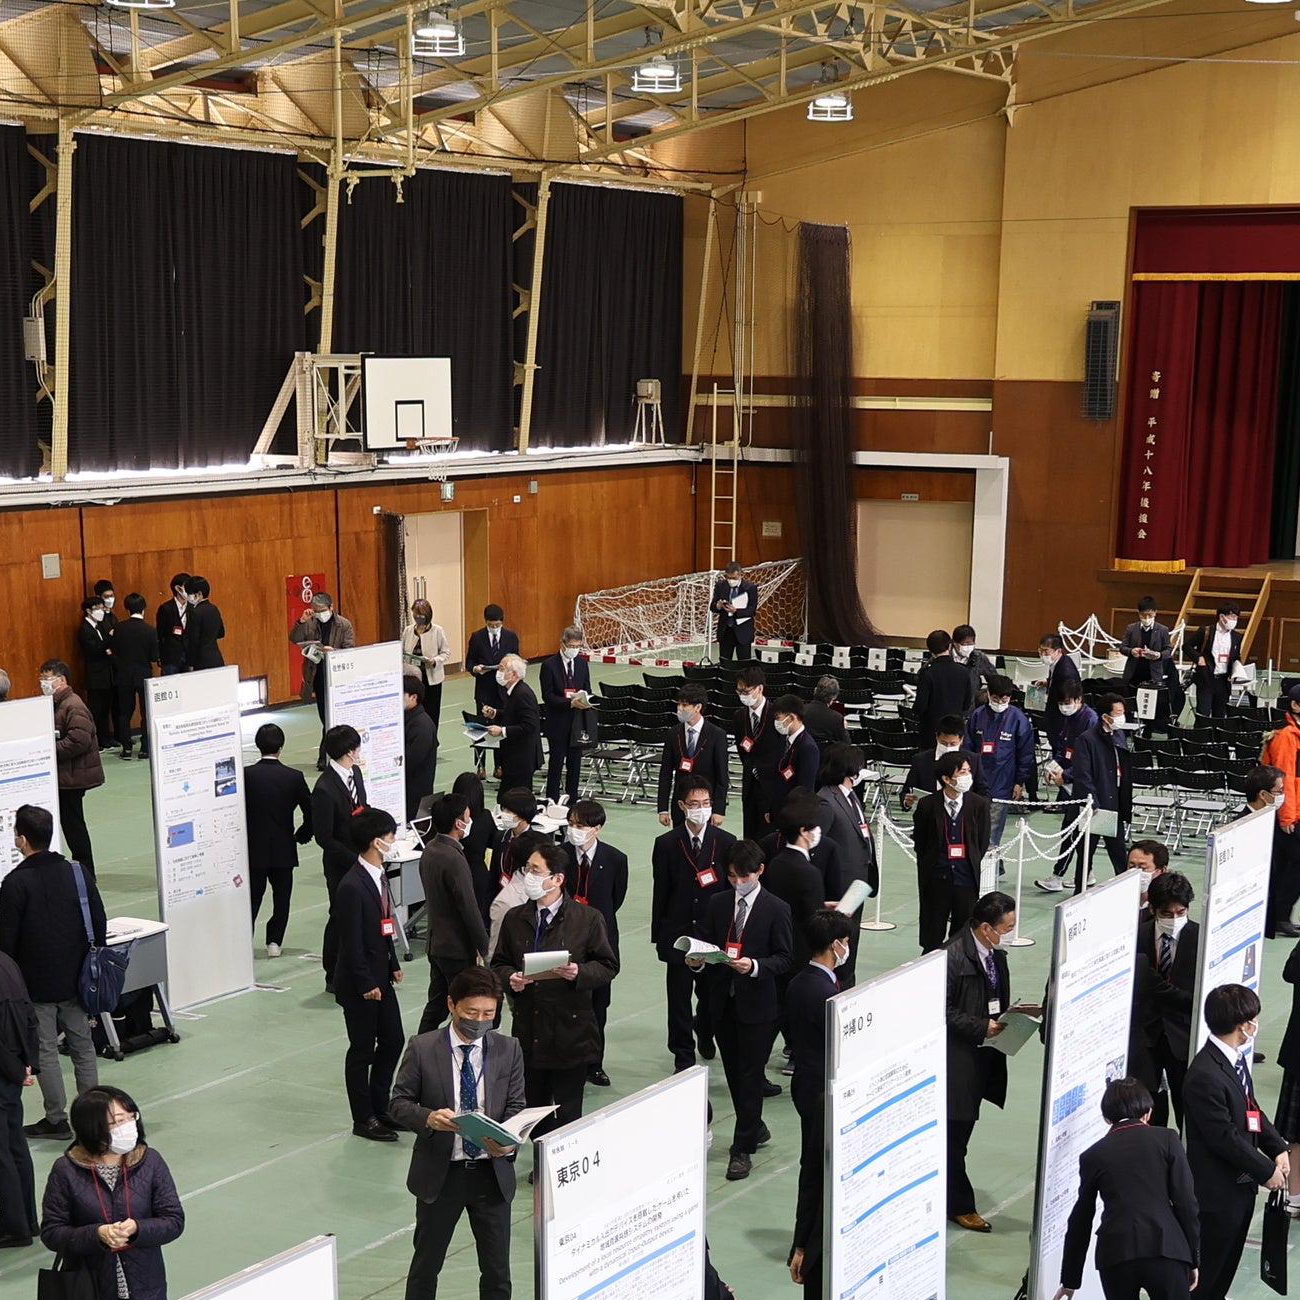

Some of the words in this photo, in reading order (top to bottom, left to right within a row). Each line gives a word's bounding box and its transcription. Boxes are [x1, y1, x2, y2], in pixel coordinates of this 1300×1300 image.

[555, 1148, 601, 1191] 東京０４
[558, 1229, 577, 1249] 東京04
[558, 1259, 590, 1287] Development
